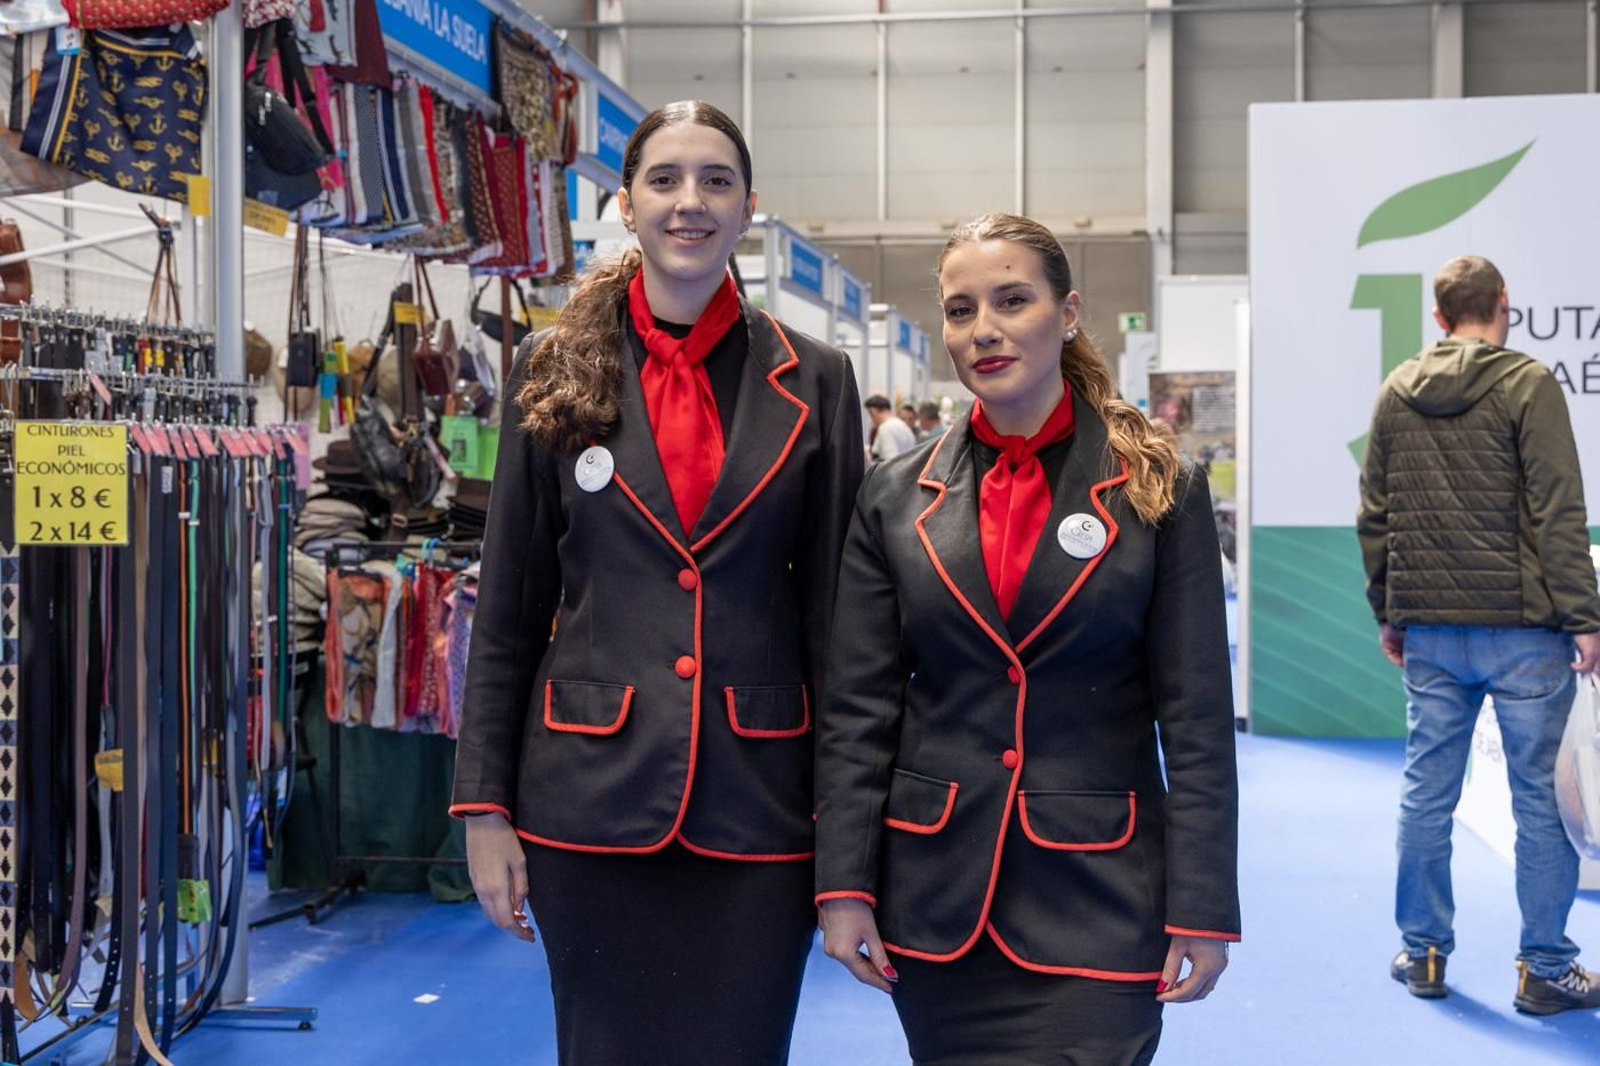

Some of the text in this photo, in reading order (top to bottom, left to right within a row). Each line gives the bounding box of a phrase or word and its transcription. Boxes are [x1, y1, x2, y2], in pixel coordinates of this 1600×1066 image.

[433, 1, 451, 42] LA
[27, 424, 115, 437] CINTURONES
[57, 444, 86, 457] PIEL
[16, 460, 126, 475] ECONÓMICOS
[32, 485, 111, 508] 1 x 8 €
[29, 521, 118, 541] 2 x 14 €
